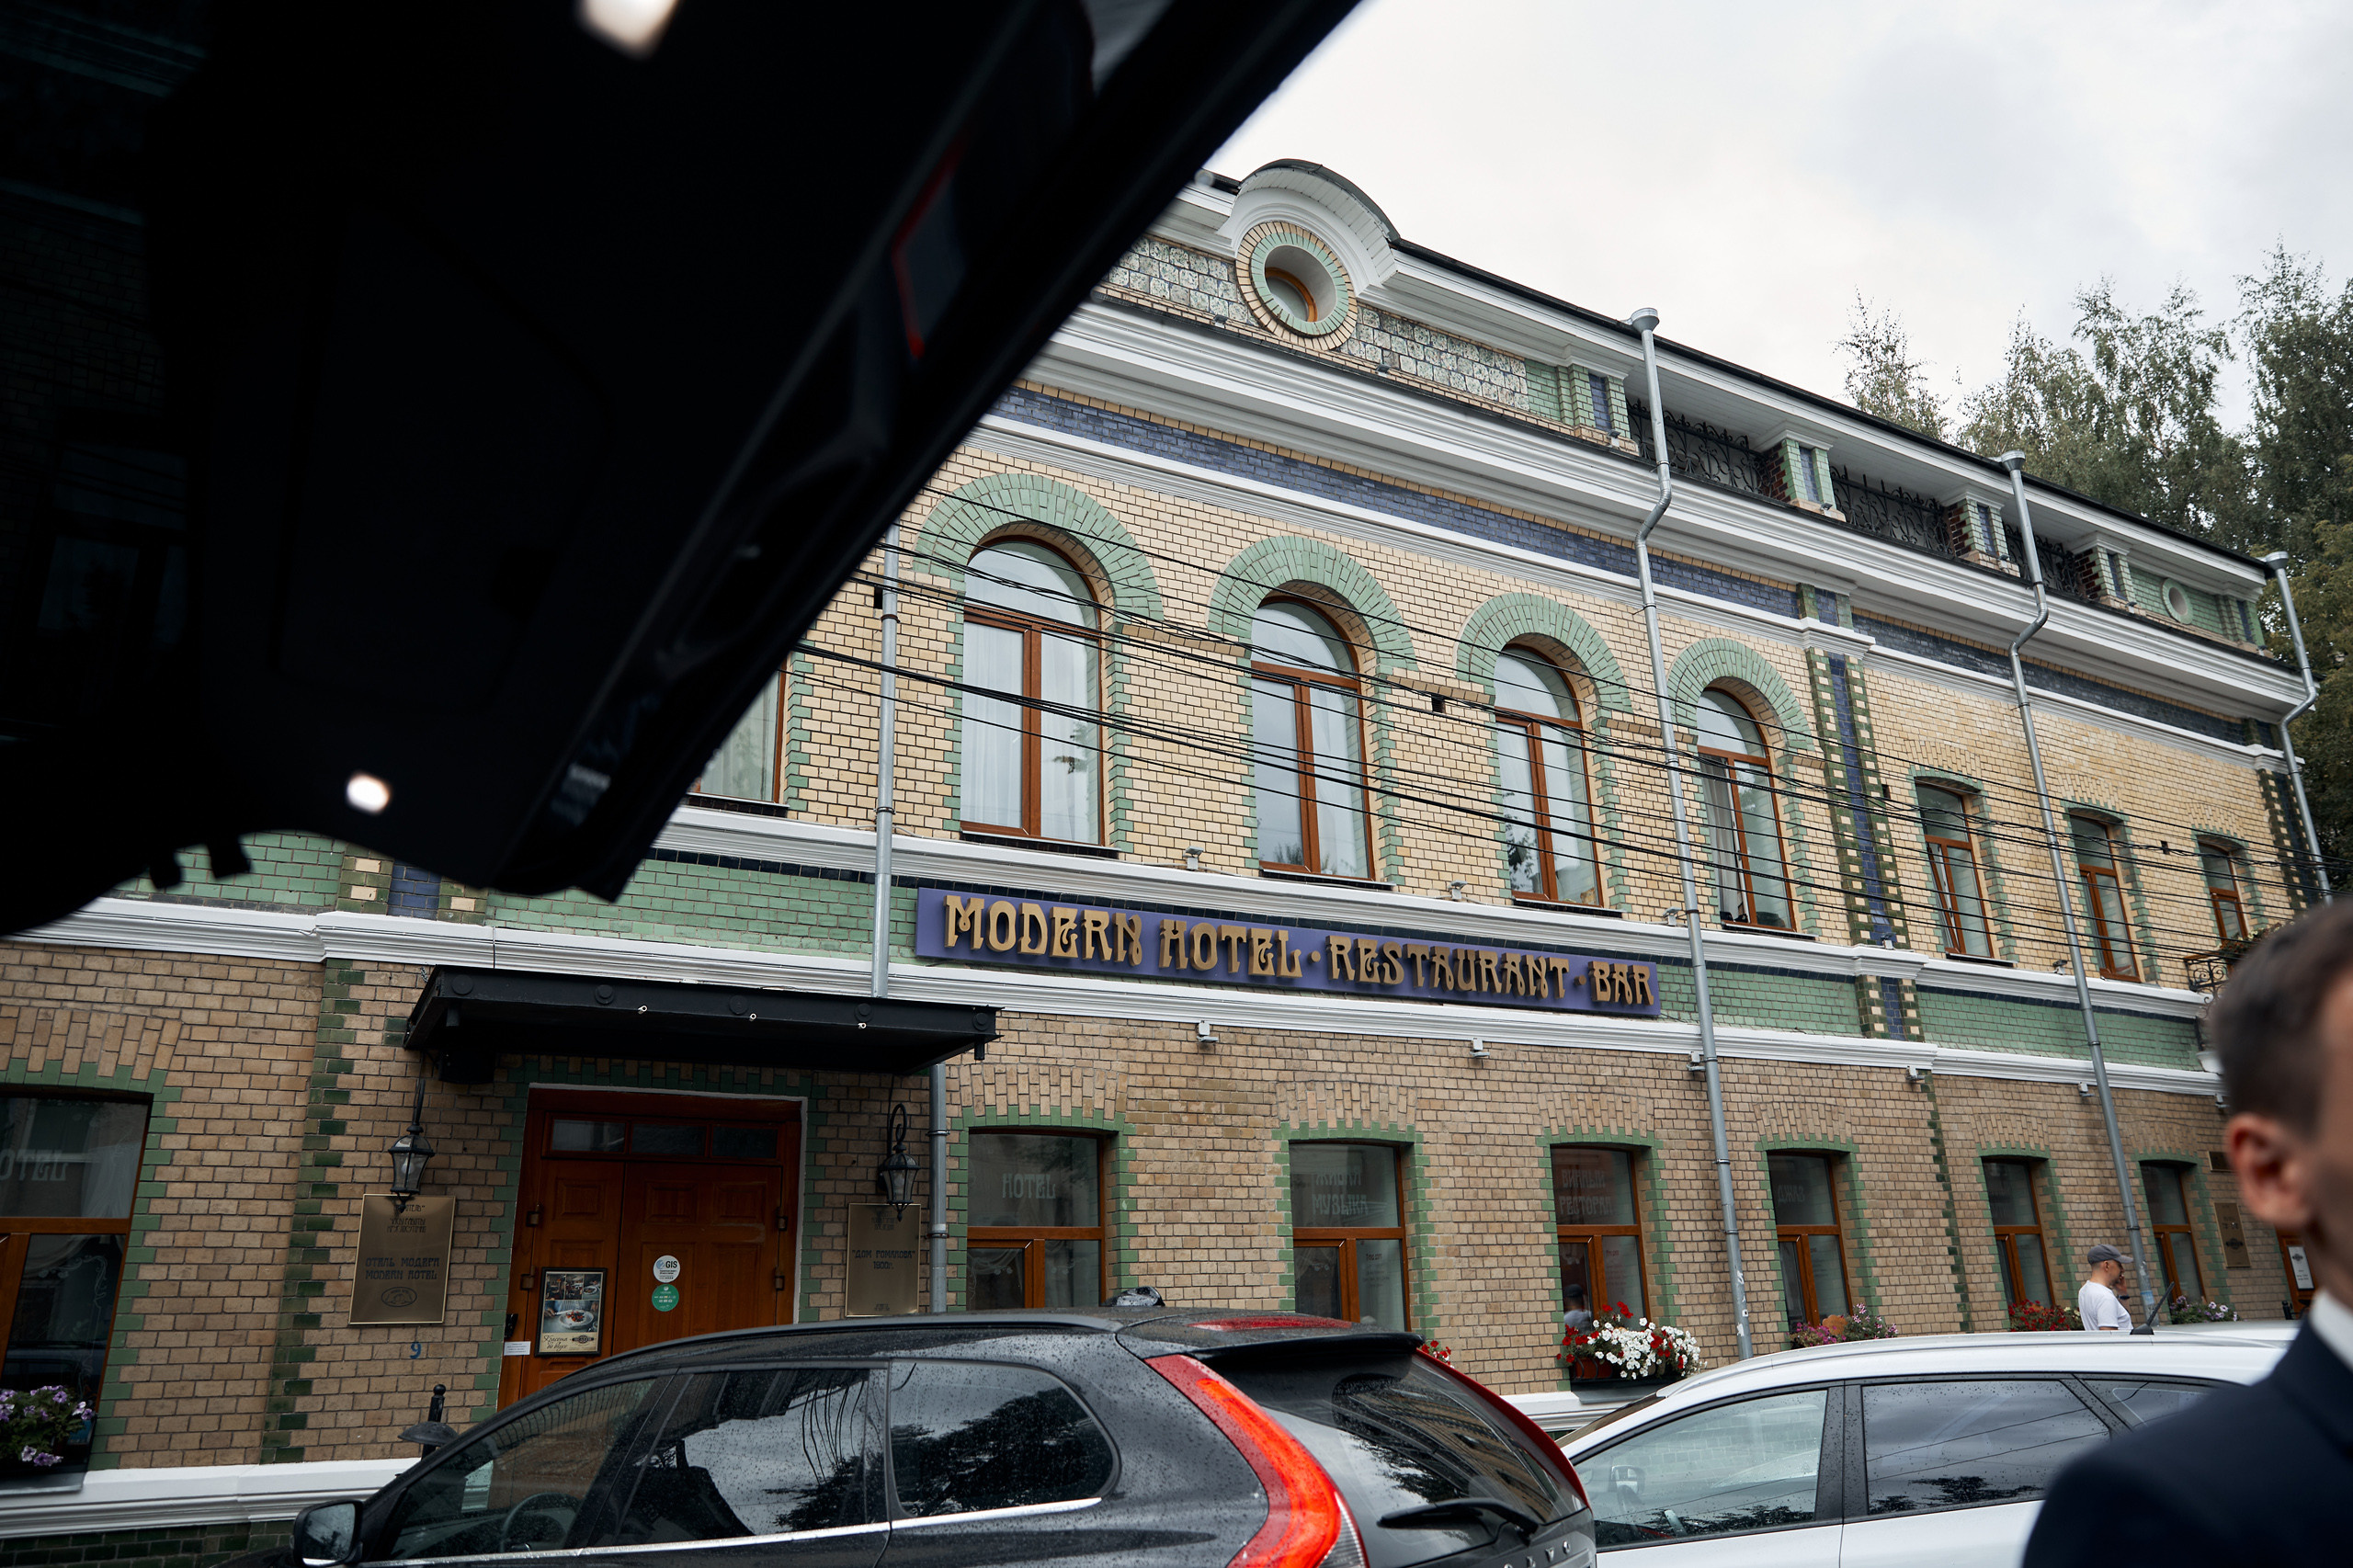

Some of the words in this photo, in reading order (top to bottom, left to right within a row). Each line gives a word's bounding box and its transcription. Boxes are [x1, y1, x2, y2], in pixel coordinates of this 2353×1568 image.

[943, 894, 1142, 967] MODERN
[1158, 919, 1303, 978] HOTEL
[1325, 935, 1570, 999] RESTAURANT
[1587, 960, 1654, 1006] BAR
[1002, 1173, 1056, 1199] HOTEL
[1312, 1194, 1369, 1216] МУЗЫКА
[1560, 1197, 1613, 1216] РЕСТОРАН
[365, 1256, 395, 1267] ОТЕЛЬ
[665, 1260, 677, 1268] GIS
[365, 1269, 404, 1280] MODERN
[408, 1269, 438, 1280] HOTEL
[410, 1341, 421, 1359] 9
